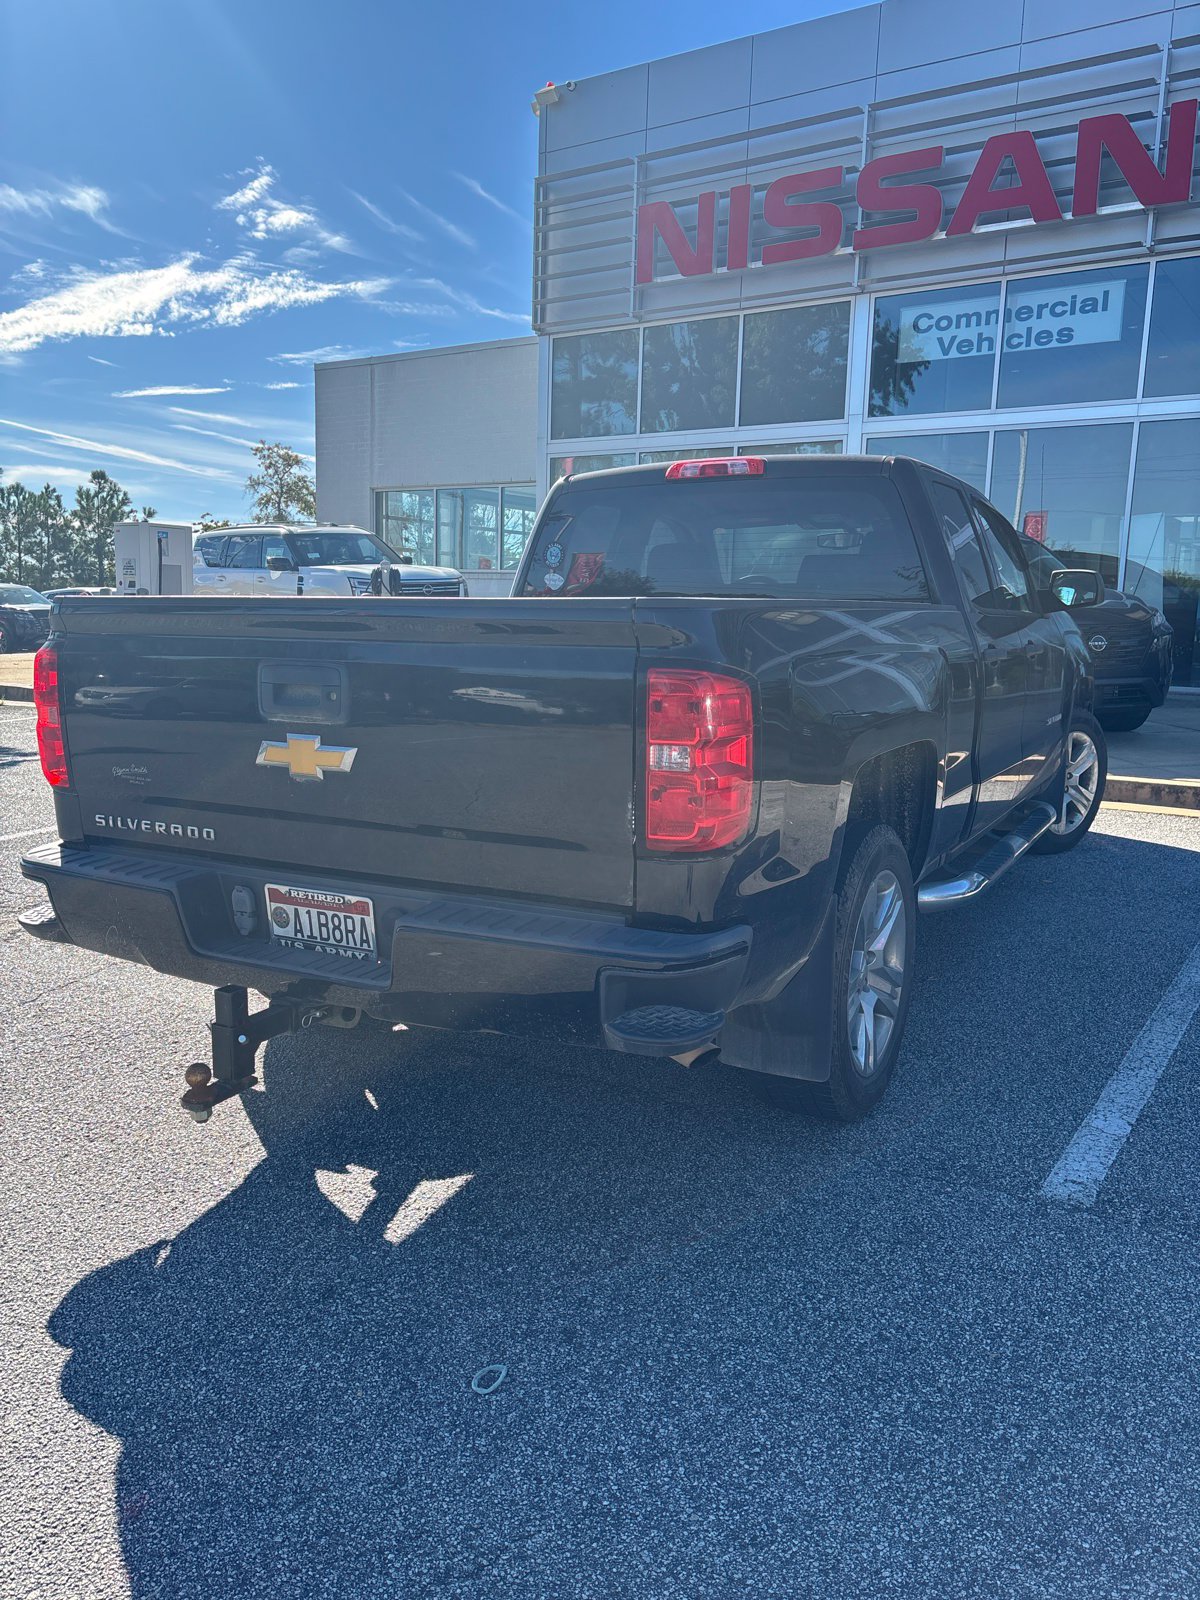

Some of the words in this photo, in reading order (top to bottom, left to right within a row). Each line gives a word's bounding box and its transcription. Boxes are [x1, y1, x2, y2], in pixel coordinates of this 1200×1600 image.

[637, 99, 1199, 284] NISSAN
[912, 290, 1111, 334] Commercial
[936, 326, 1076, 357] Vehcles
[95, 814, 216, 841] SILVERADO
[290, 890, 344, 904] RETIRED
[293, 907, 371, 948] A1B8RA
[280, 939, 304, 949] US
[315, 945, 365, 960] ARMY
